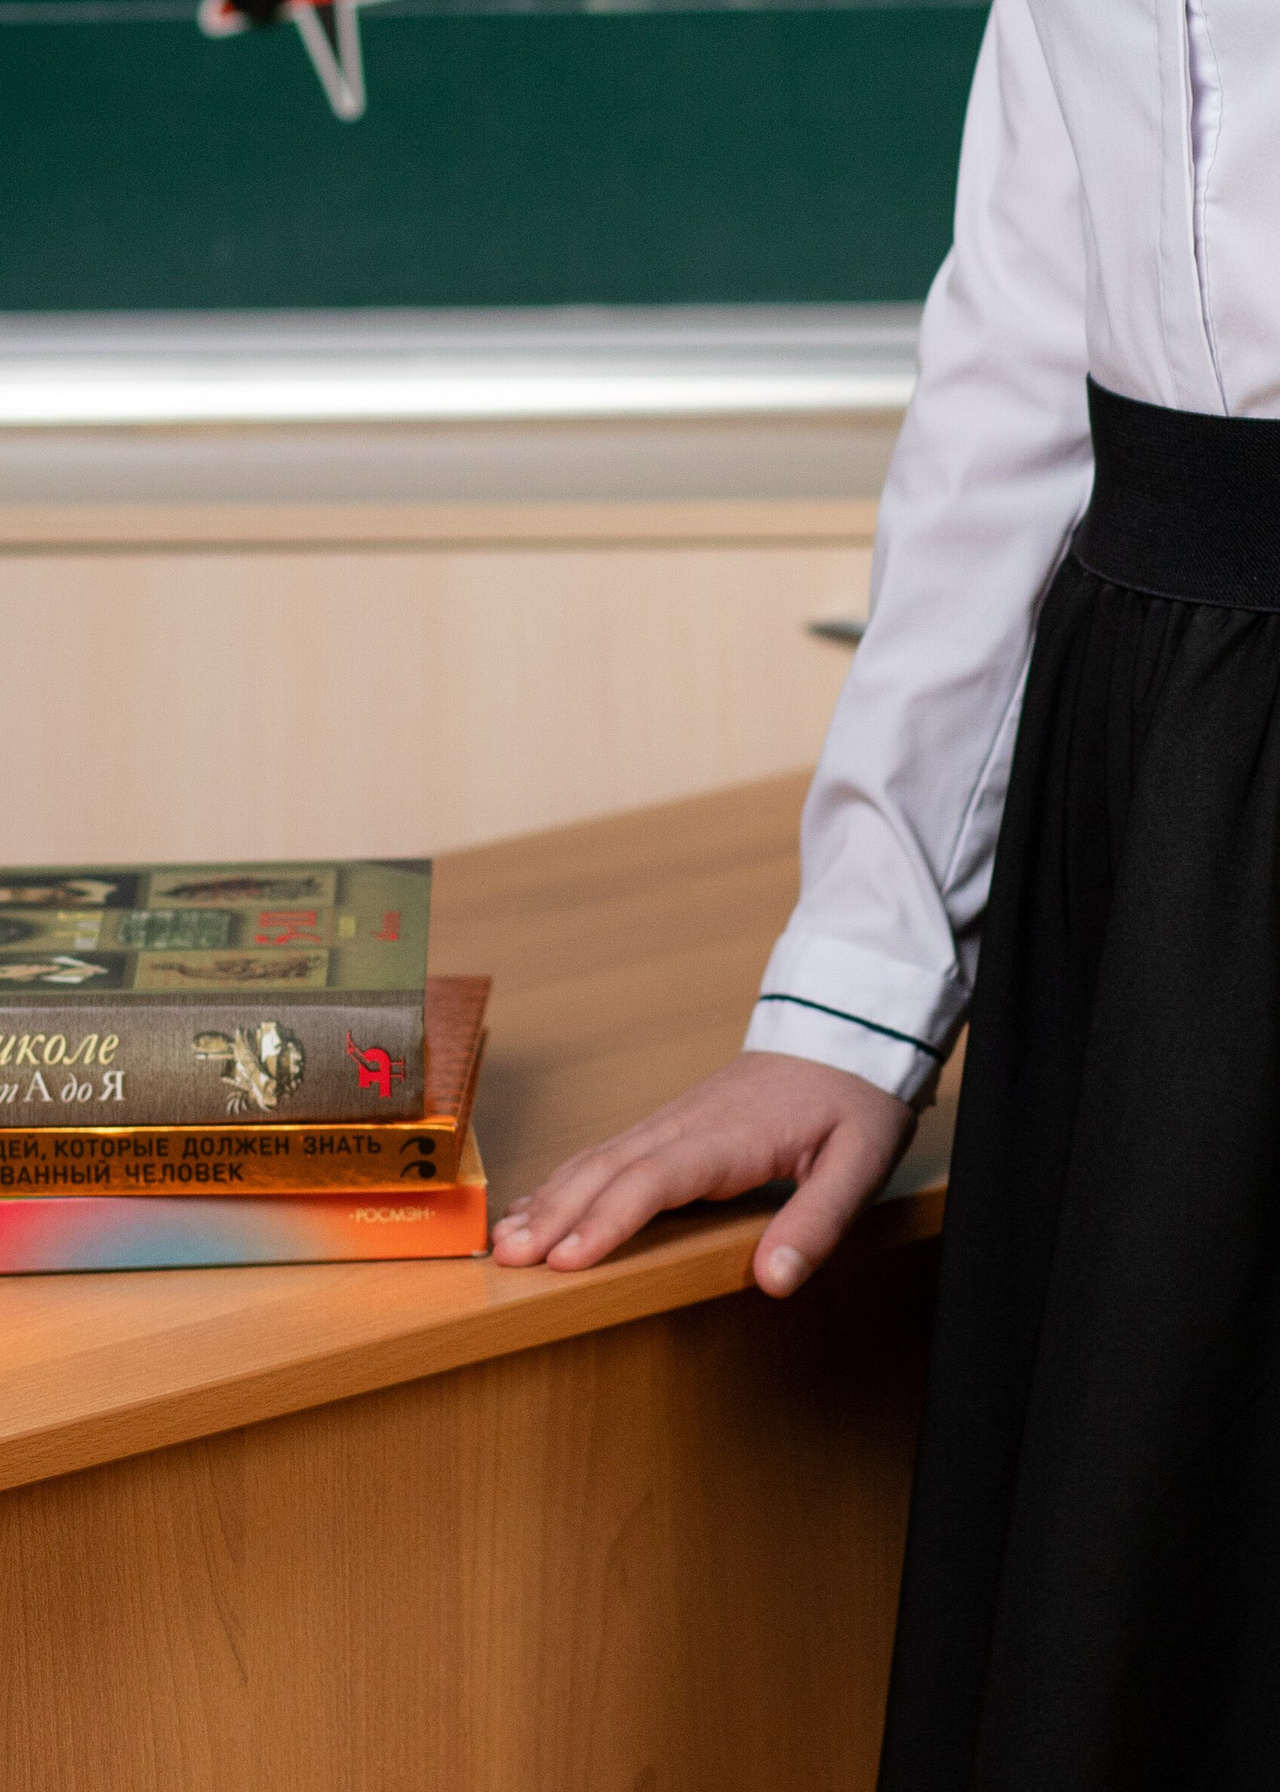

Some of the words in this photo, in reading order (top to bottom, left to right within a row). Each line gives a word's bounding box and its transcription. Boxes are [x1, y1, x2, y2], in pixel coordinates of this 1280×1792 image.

[60, 1072, 93, 1103] до
[98, 1069, 126, 1102] Я
[54, 1137, 170, 1159] КОТОРЫЕ
[182, 1136, 290, 1159] ДОЛЖЕН
[303, 1135, 382, 1156] ЗНАТЬ
[0, 1160, 111, 1185] ВАННЫЙ
[125, 1162, 244, 1183] ЧЕЛОВЕК
